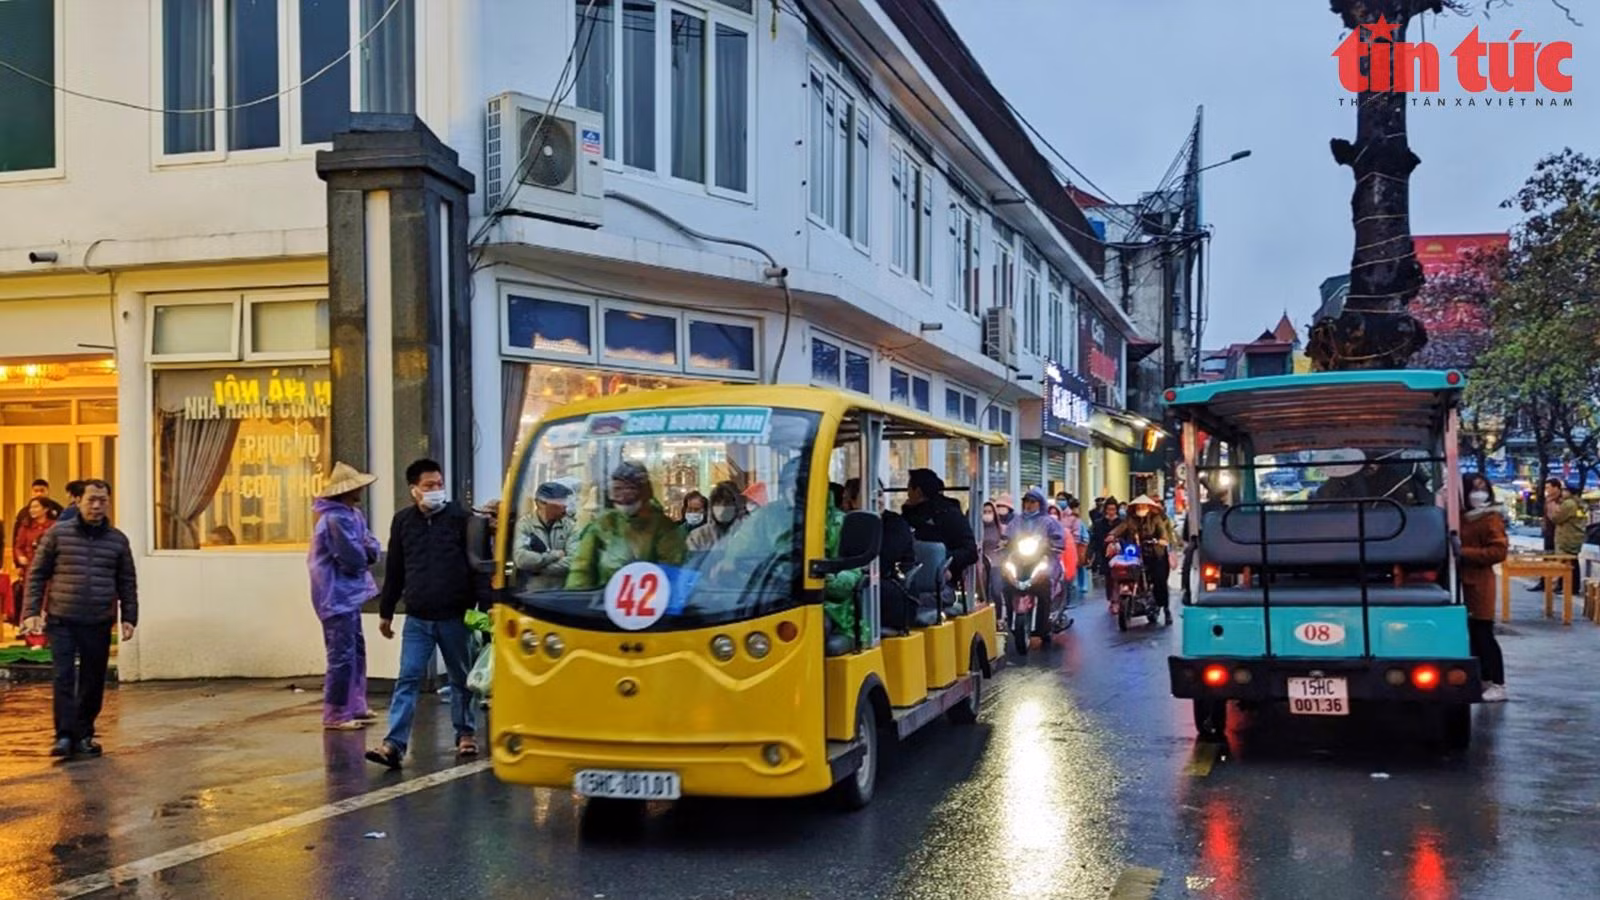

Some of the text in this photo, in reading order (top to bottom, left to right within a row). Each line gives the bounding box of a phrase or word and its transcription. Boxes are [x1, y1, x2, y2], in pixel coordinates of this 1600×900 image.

[720, 413, 765, 431] XANH
[615, 573, 658, 617] 42
[1304, 624, 1330, 641] 08
[1301, 679, 1335, 696] 15HC
[1294, 698, 1343, 712] 001.36
